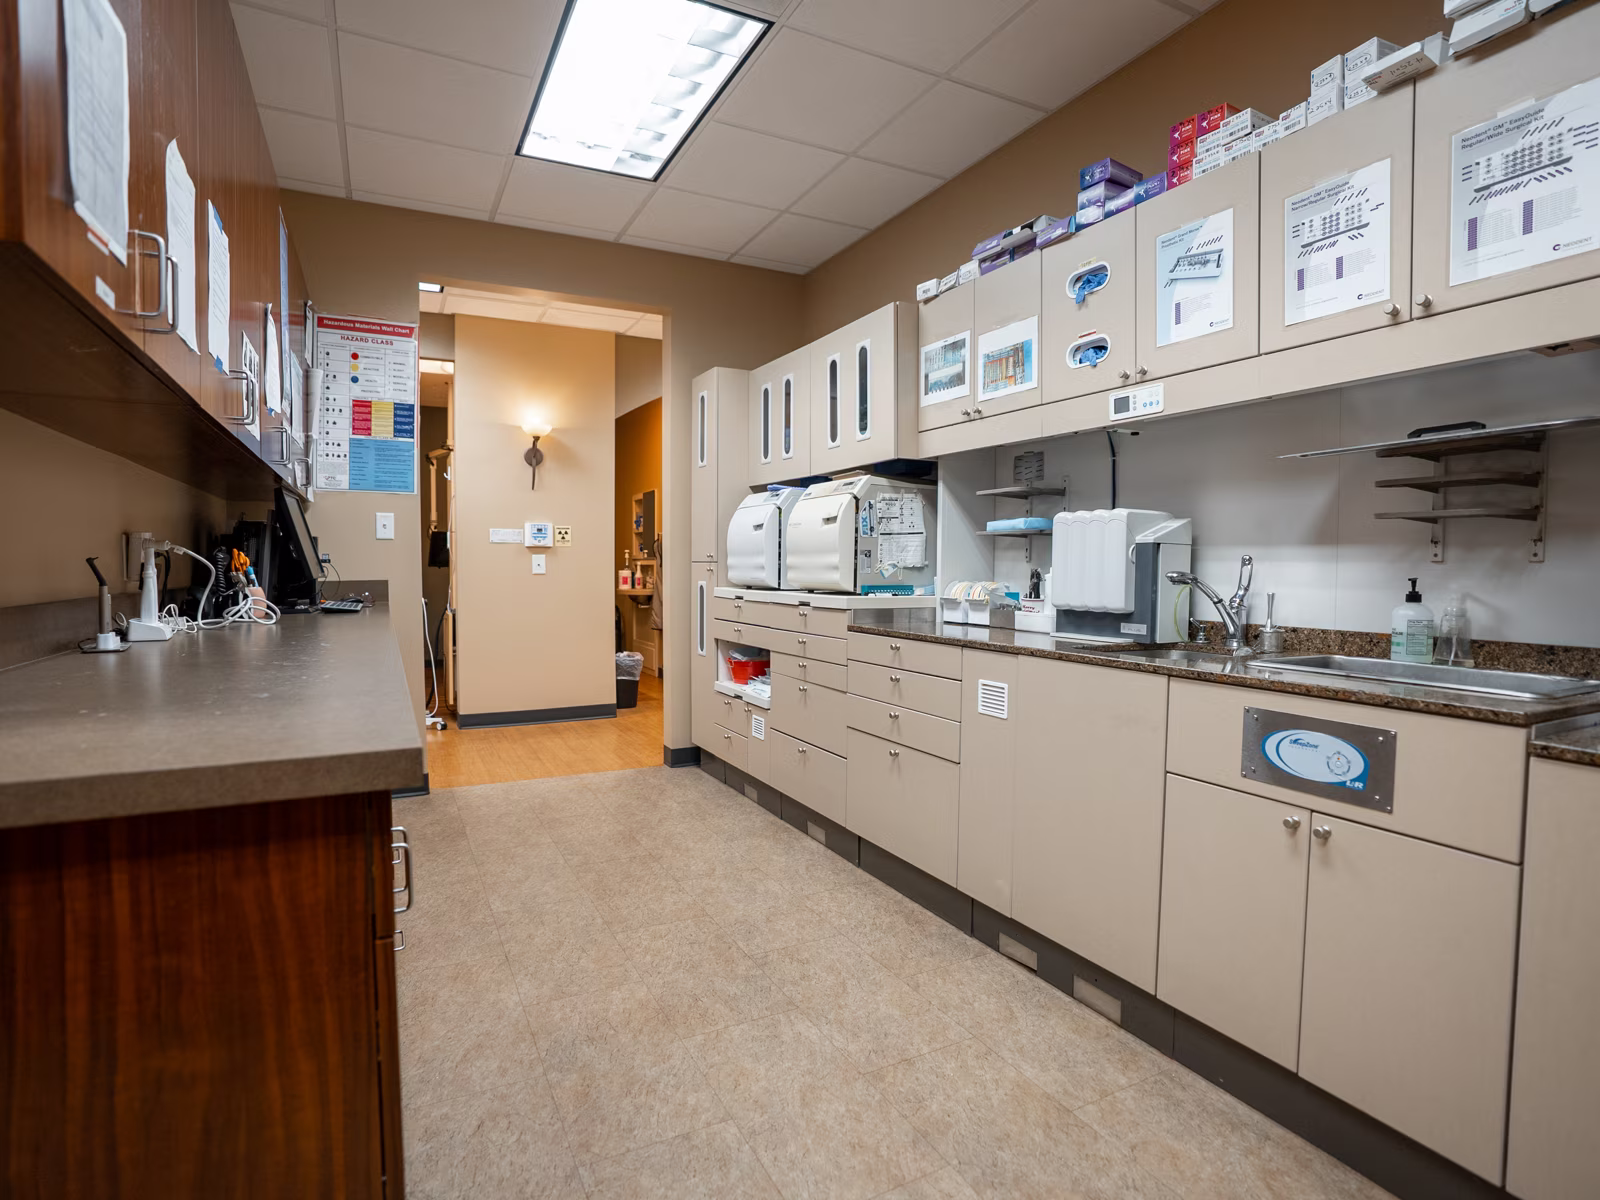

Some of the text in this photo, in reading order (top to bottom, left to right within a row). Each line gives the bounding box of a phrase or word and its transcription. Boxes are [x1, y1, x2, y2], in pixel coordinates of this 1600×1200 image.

[1508, 108, 1545, 125] EasyGuide
[1461, 131, 1503, 150] Regular/Wide
[1505, 120, 1532, 133] Surgical
[1327, 187, 1346, 198] Surgical
[323, 319, 354, 328] Hazardous
[355, 322, 380, 330] Materials
[395, 326, 410, 334] Chart
[340, 335, 394, 346] HAZARD CLASS
